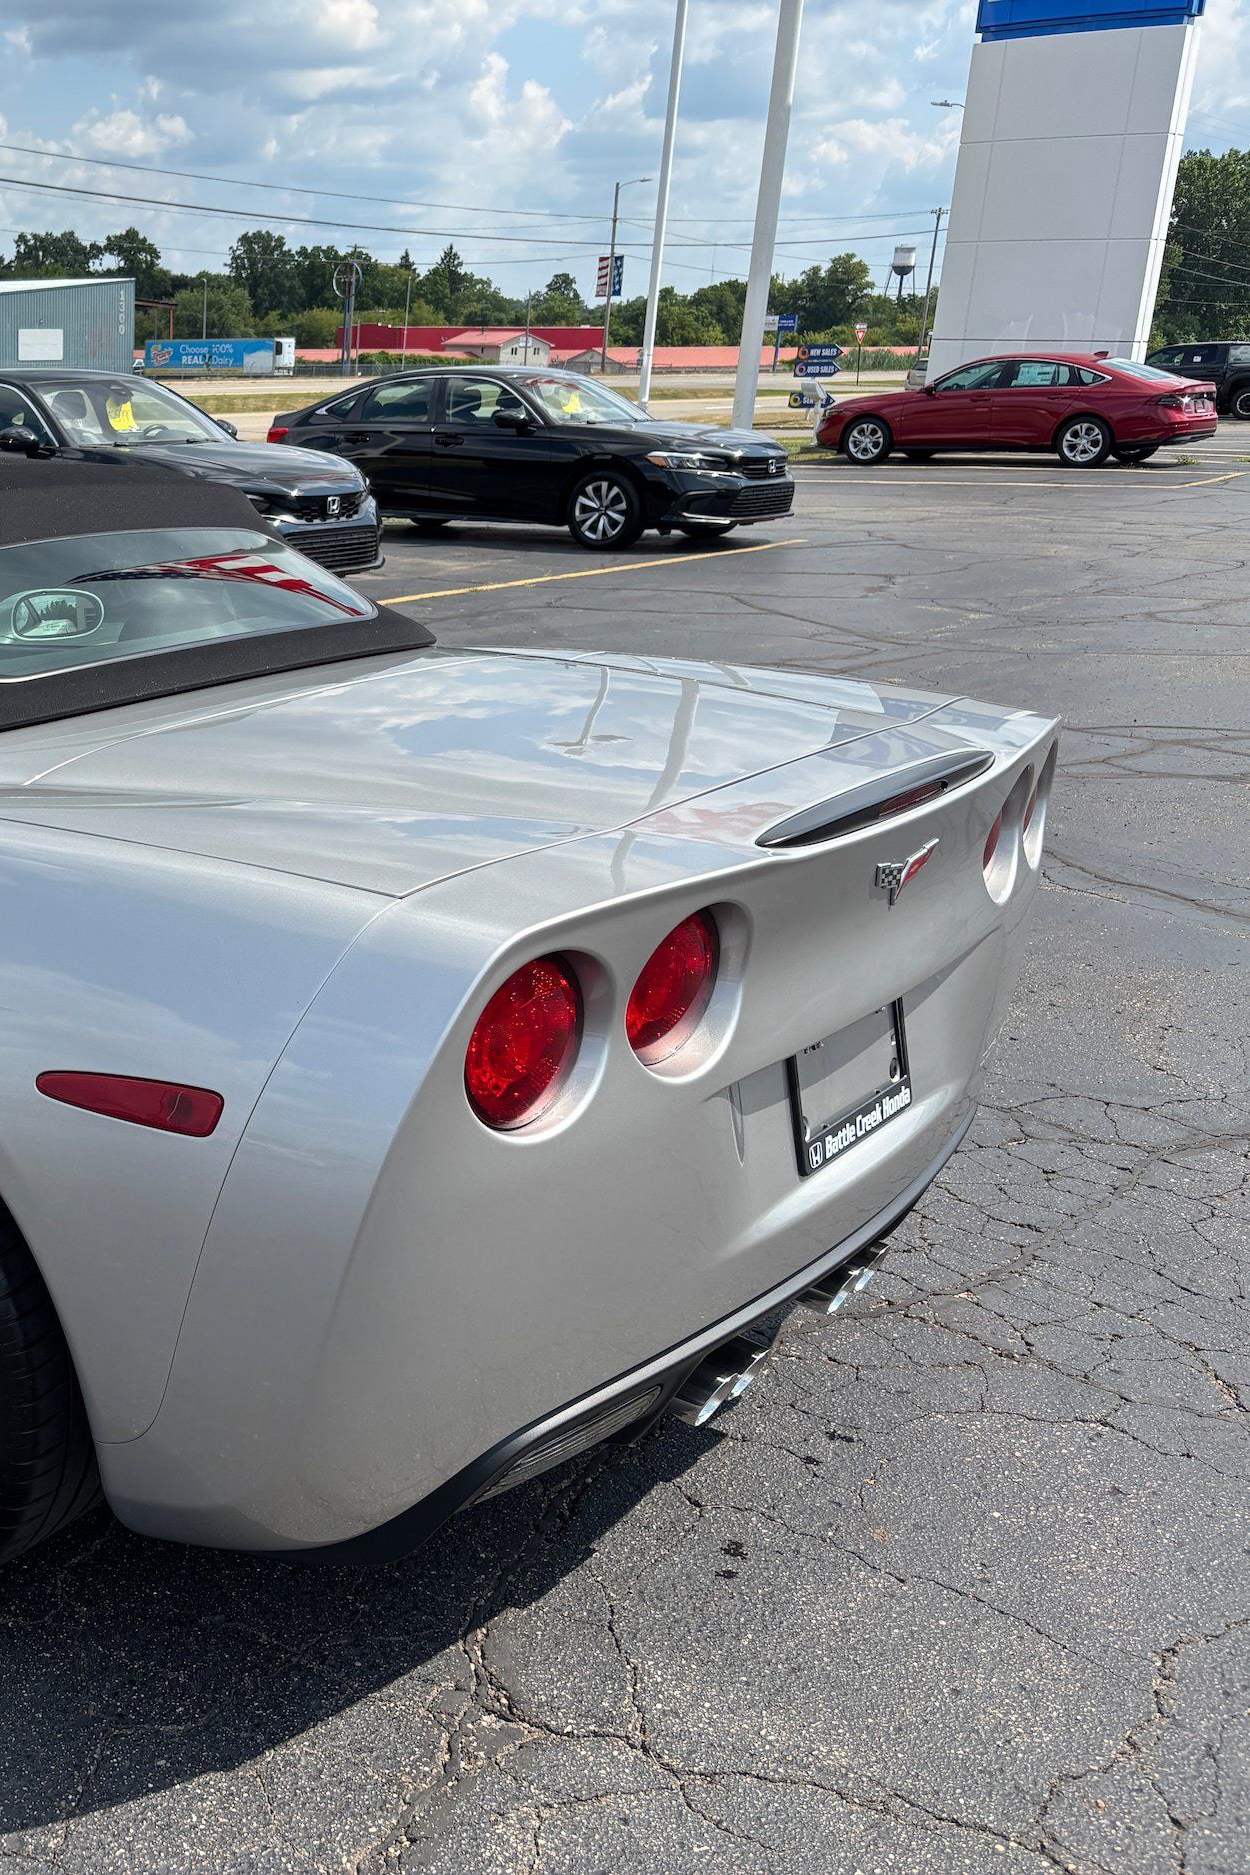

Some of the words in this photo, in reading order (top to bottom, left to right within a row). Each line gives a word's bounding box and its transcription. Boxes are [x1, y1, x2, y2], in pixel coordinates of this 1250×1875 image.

[179, 344, 209, 353] Choose
[212, 343, 234, 354] 100%
[810, 348, 821, 356] NEW
[821, 347, 837, 356] SALES
[181, 355, 204, 365] REAL
[212, 355, 234, 367] Dairy
[807, 366, 819, 374] USED
[819, 365, 835, 374] SALES
[825, 1123, 856, 1159] Battle
[856, 1103, 882, 1138] Creek
[882, 1086, 910, 1120] Honda
